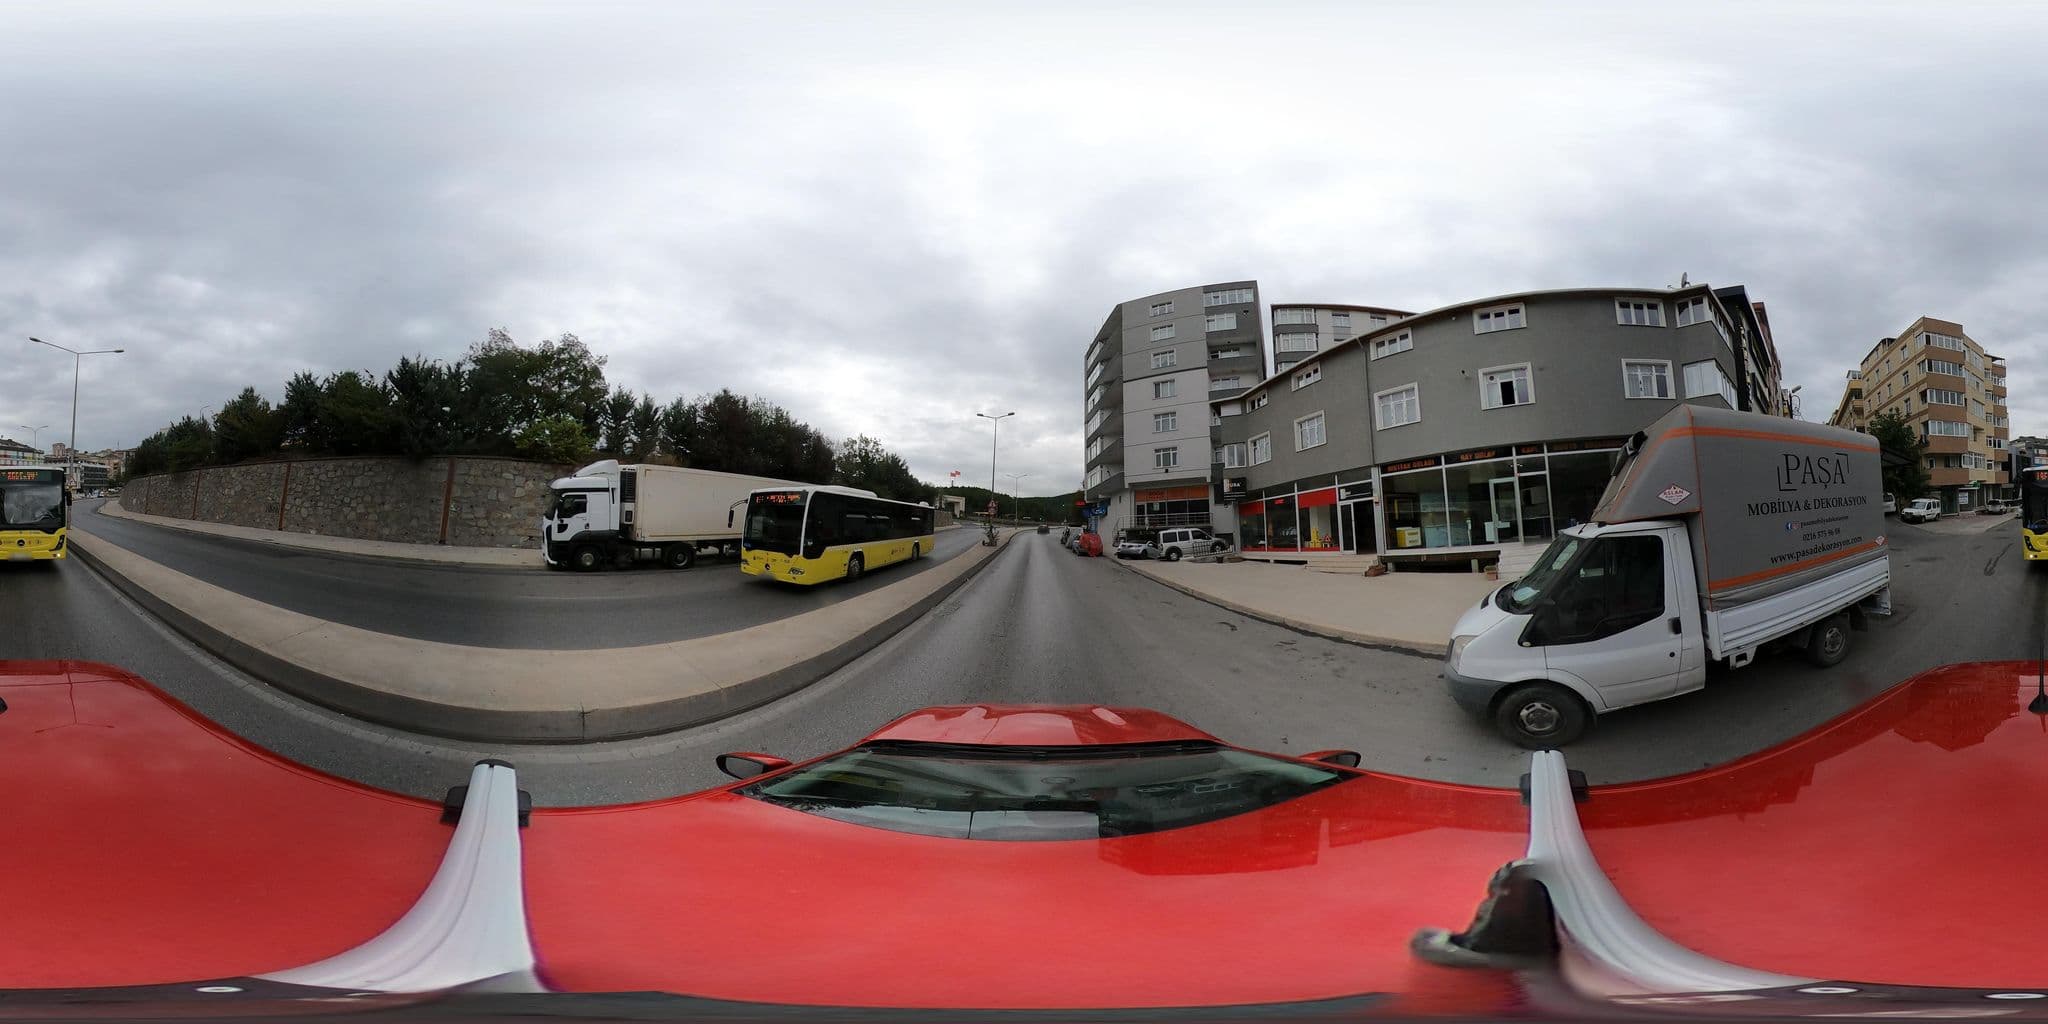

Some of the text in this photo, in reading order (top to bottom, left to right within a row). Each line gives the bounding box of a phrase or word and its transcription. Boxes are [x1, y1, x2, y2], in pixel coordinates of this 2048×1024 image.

[1782, 453, 1846, 488] PAŞA
[1748, 495, 1867, 516] MOBİLYA & DEKORASYON
[1770, 536, 1862, 564] www.pasadekorasyon.com
